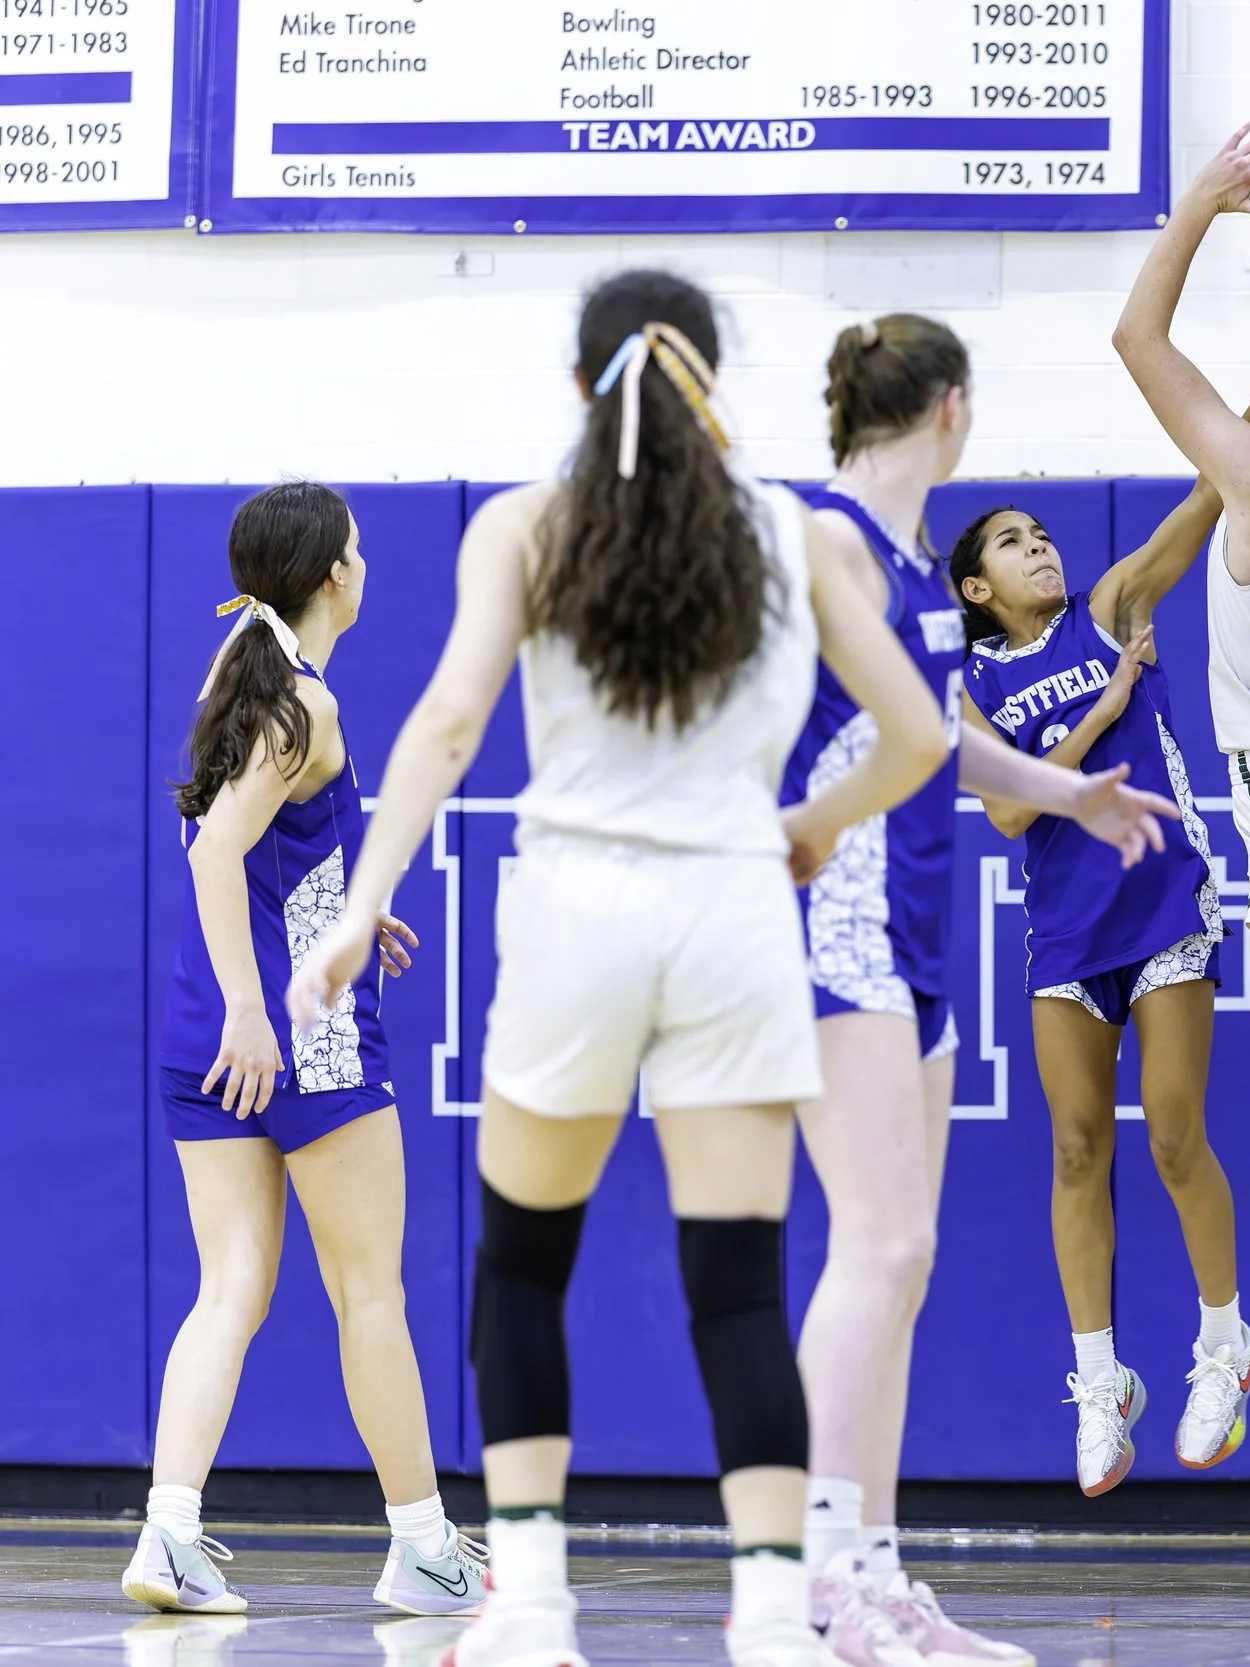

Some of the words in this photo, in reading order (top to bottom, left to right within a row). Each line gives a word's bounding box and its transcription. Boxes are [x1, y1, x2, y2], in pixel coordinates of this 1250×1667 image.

[281, 12, 335, 35] Mike
[346, 14, 415, 34] Tirone
[563, 9, 654, 38] Bowling
[974, 4, 1104, 26] 1980-2011
[2, 32, 126, 55] 1971-1983
[280, 50, 306, 73] Ed
[316, 49, 426, 73] Tranchina
[561, 47, 646, 70] Athletic
[658, 48, 750, 70] Director
[973, 42, 1107, 64] 1993-2010
[561, 84, 653, 108] Football
[802, 85, 932, 107] 1985-1993
[972, 86, 1105, 108] 1996-2005
[67, 123, 121, 144] 1995
[562, 122, 669, 151] TEAM
[675, 122, 816, 149] AWARD
[0, 161, 118, 184] 998-2001
[283, 164, 335, 187] Girls
[346, 165, 415, 187] Tennis
[964, 163, 1031, 188] 1973,
[1046, 163, 1104, 184] 1974
[991, 659, 1111, 736] WSTFIELD
